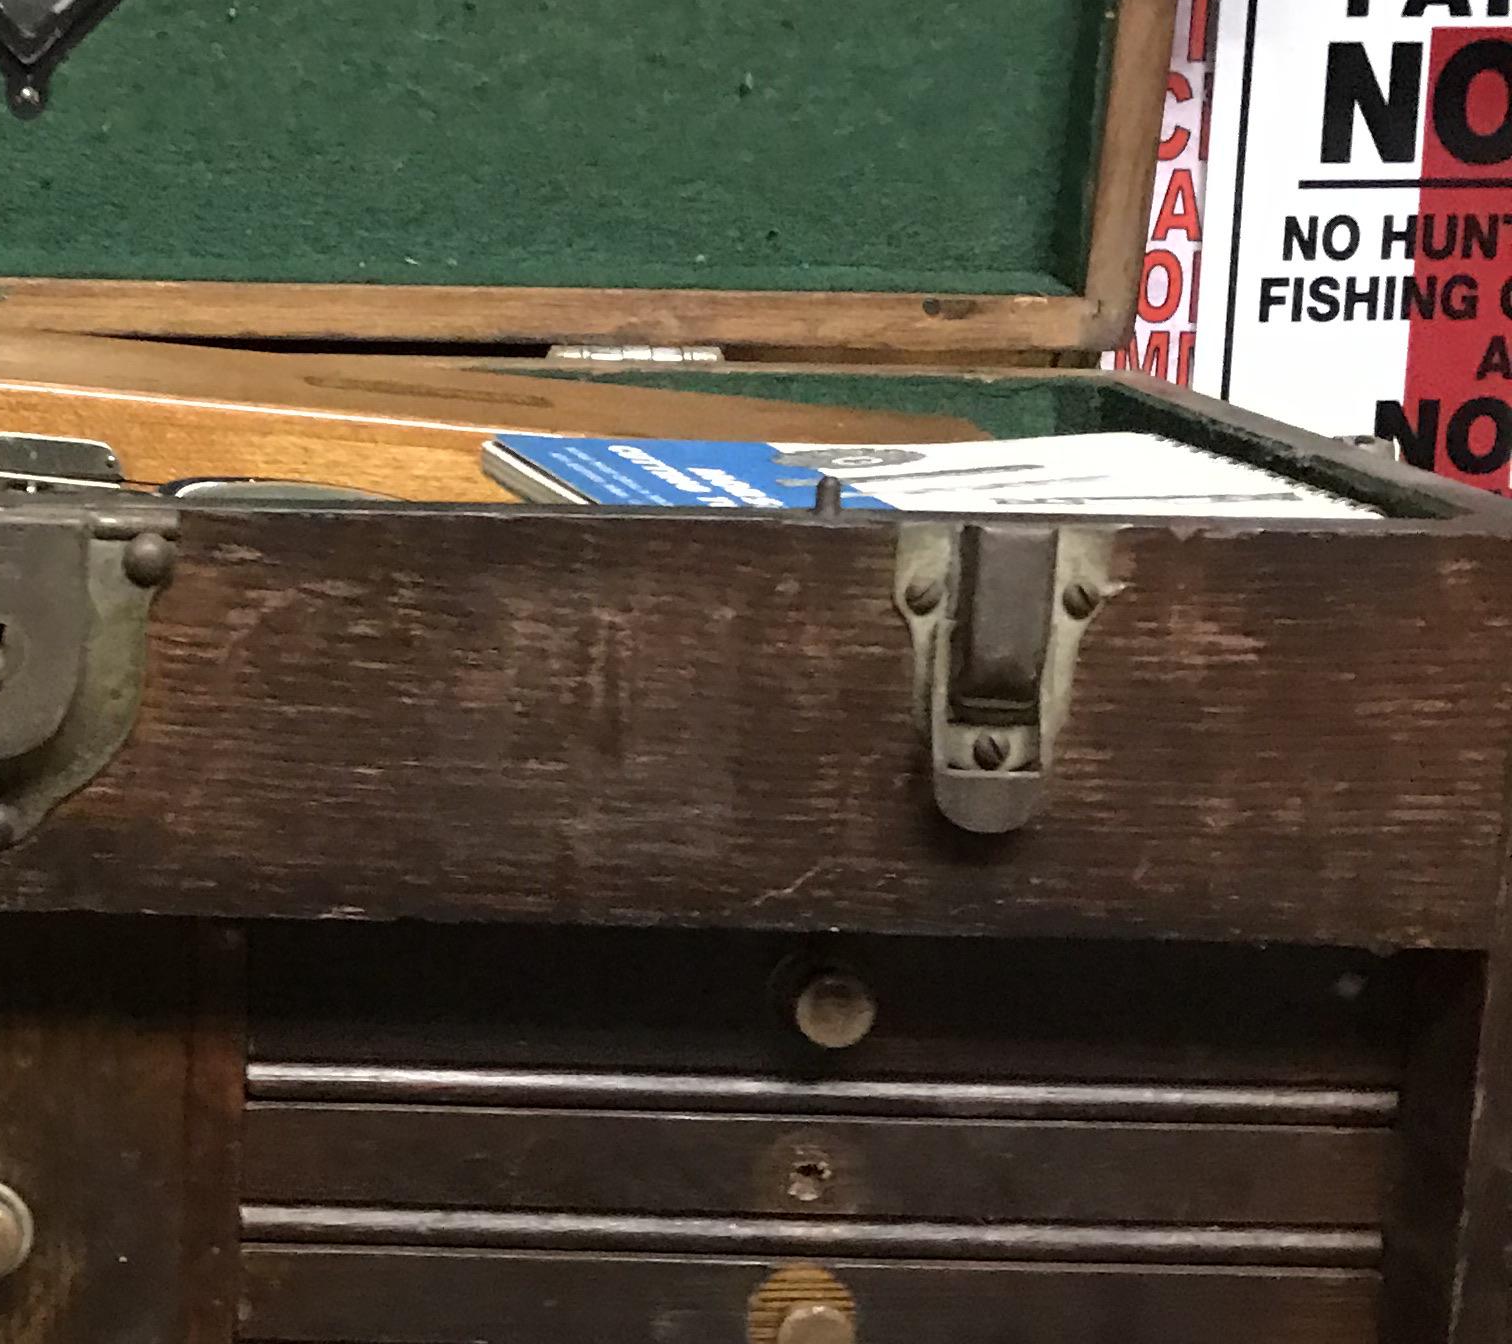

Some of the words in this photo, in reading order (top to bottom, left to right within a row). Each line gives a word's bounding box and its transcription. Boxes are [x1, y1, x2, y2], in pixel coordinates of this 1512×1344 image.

[1320, 39, 1512, 166] NO
[1282, 214, 1361, 261] NO
[1380, 213, 1512, 261] HUN
[1258, 274, 1479, 323] FISHING
[1374, 396, 1512, 475] NO
